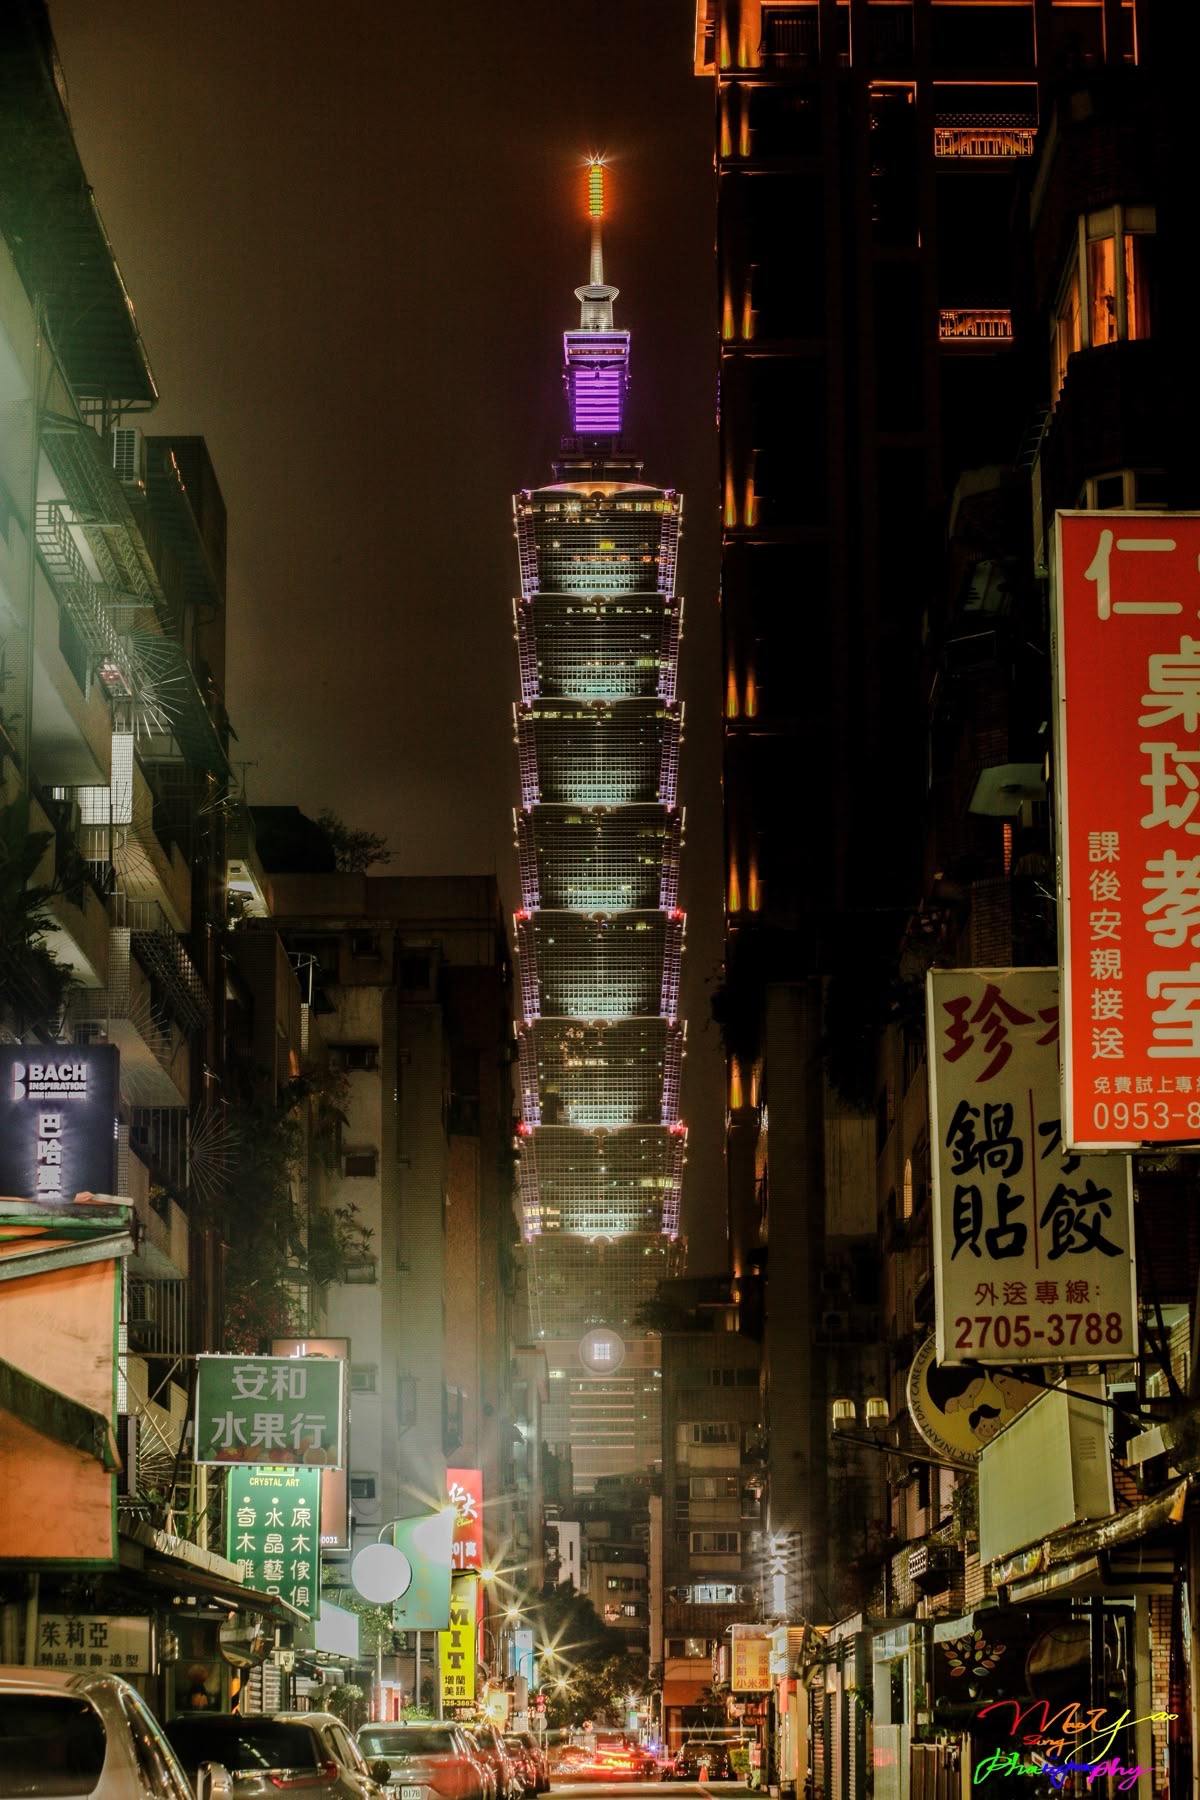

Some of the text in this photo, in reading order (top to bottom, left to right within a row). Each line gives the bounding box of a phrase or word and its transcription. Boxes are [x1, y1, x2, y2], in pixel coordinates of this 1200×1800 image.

[1084, 529, 1200, 621] 仁
[1088, 832, 1124, 1059] 課後安親接送
[942, 984, 1060, 1083] 珍
[29, 1064, 87, 1081] BACH
[29, 1082, 87, 1091] INSPIRATION
[1093, 1076, 1200, 1095] 免費試上專
[945, 1100, 1029, 1261] 鍋貼
[954, 1312, 1123, 1349] 2705-3788
[232, 1364, 307, 1401] 安和
[911, 1367, 921, 1395] CARE
[910, 1400, 925, 1421] DAY
[211, 1411, 327, 1450] 水果行
[921, 1423, 956, 1458] INFANT
[250, 1478, 300, 1487] CRYSTAL ART
[236, 1507, 256, 1592] 奇木雕
[291, 1508, 311, 1607] 原木傢俱
[41, 1621, 109, 1648] 茱莉亞
